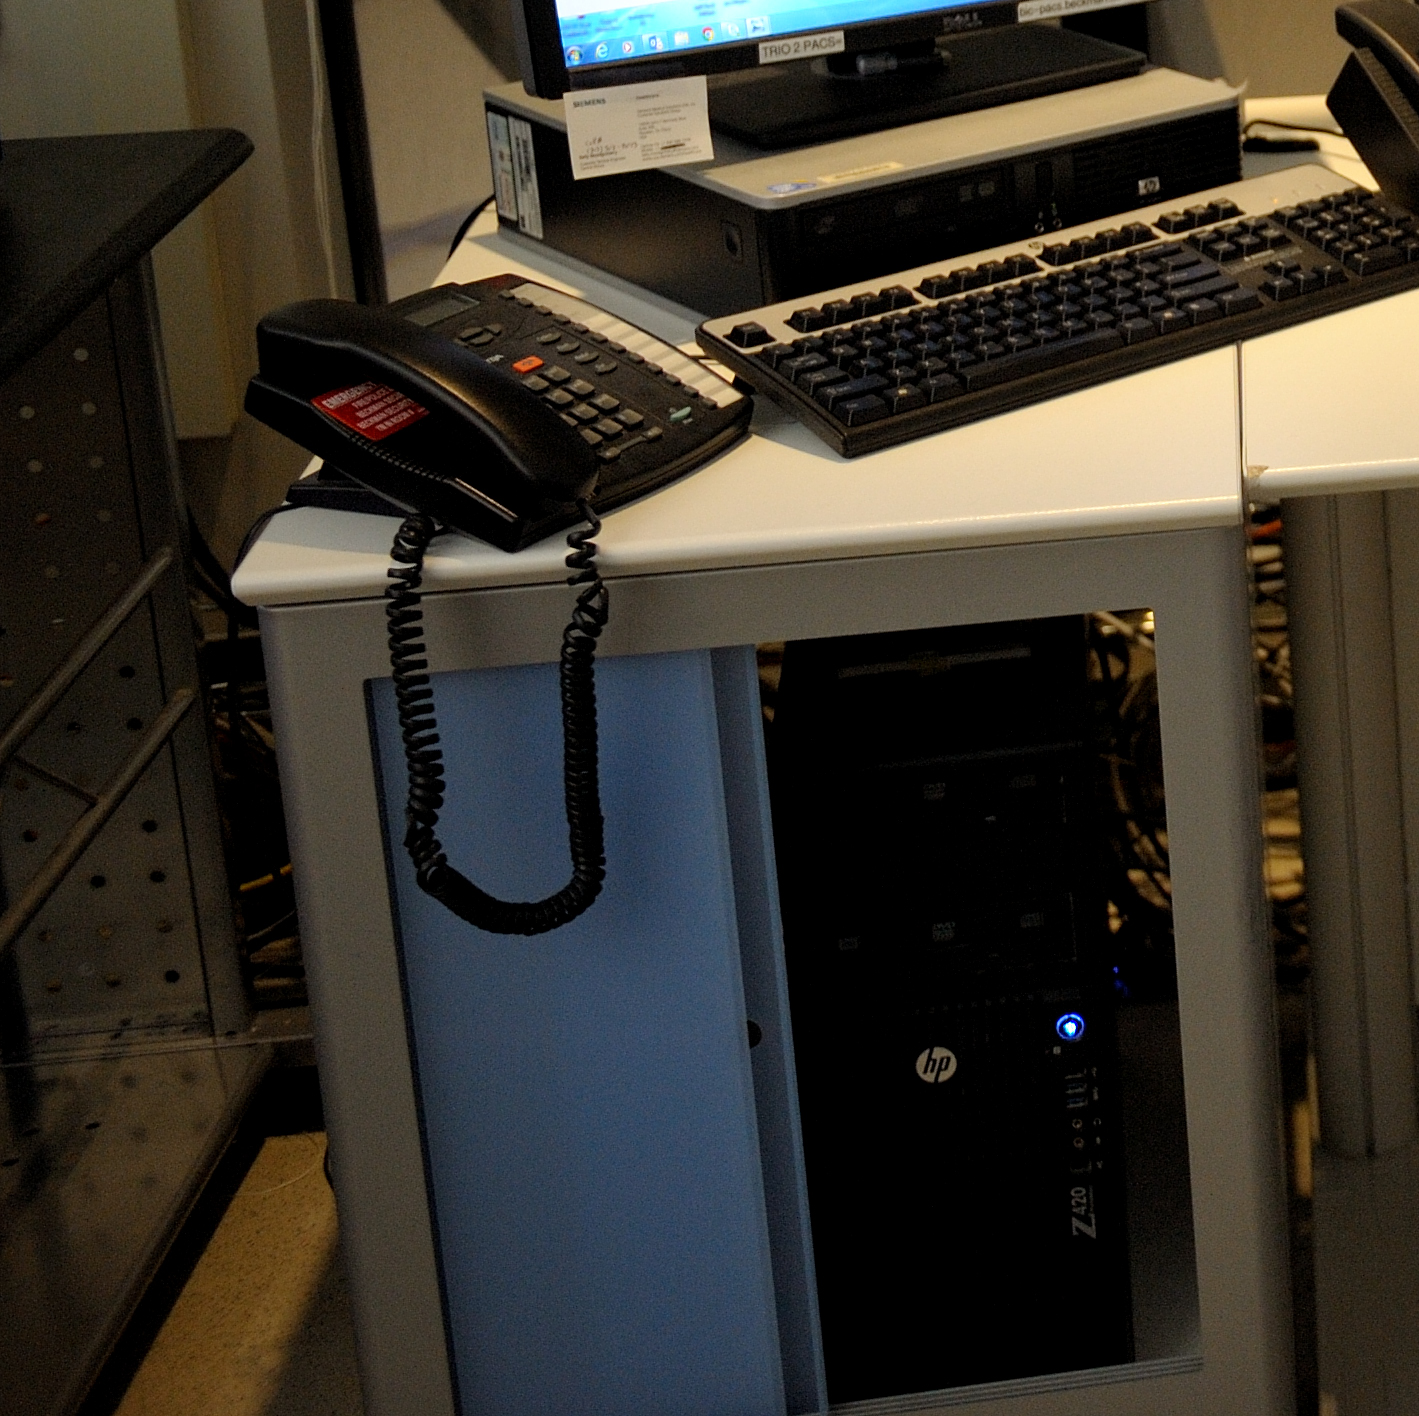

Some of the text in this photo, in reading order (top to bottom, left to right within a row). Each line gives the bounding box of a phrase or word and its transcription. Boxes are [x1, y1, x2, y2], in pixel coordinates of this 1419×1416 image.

[762, 40, 790, 58] TRIO
[792, 39, 802, 55] 2
[918, 1046, 955, 1083] hp
[1070, 1185, 1098, 1240] Z420
